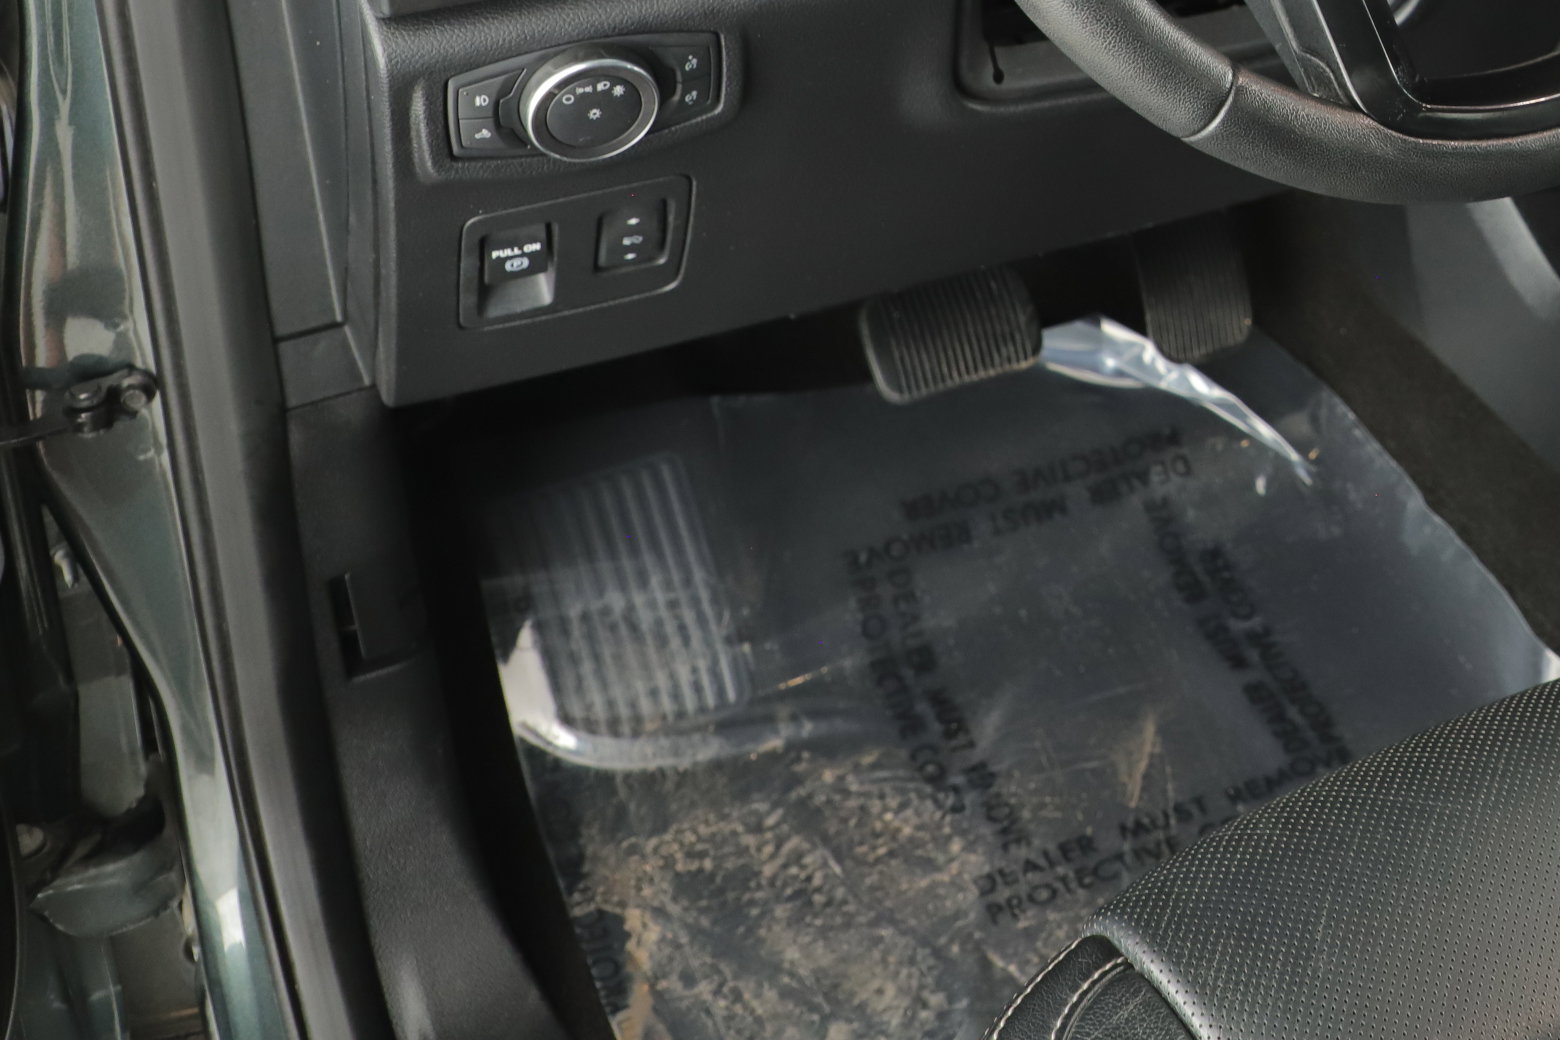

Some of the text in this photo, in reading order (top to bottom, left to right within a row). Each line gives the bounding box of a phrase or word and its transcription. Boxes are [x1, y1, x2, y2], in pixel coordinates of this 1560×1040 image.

[491, 241, 541, 260] PULL ON
[972, 832, 1097, 898] DEALER
[1119, 794, 1208, 840] MUST
[984, 834, 1180, 926] PROTECTIVE
